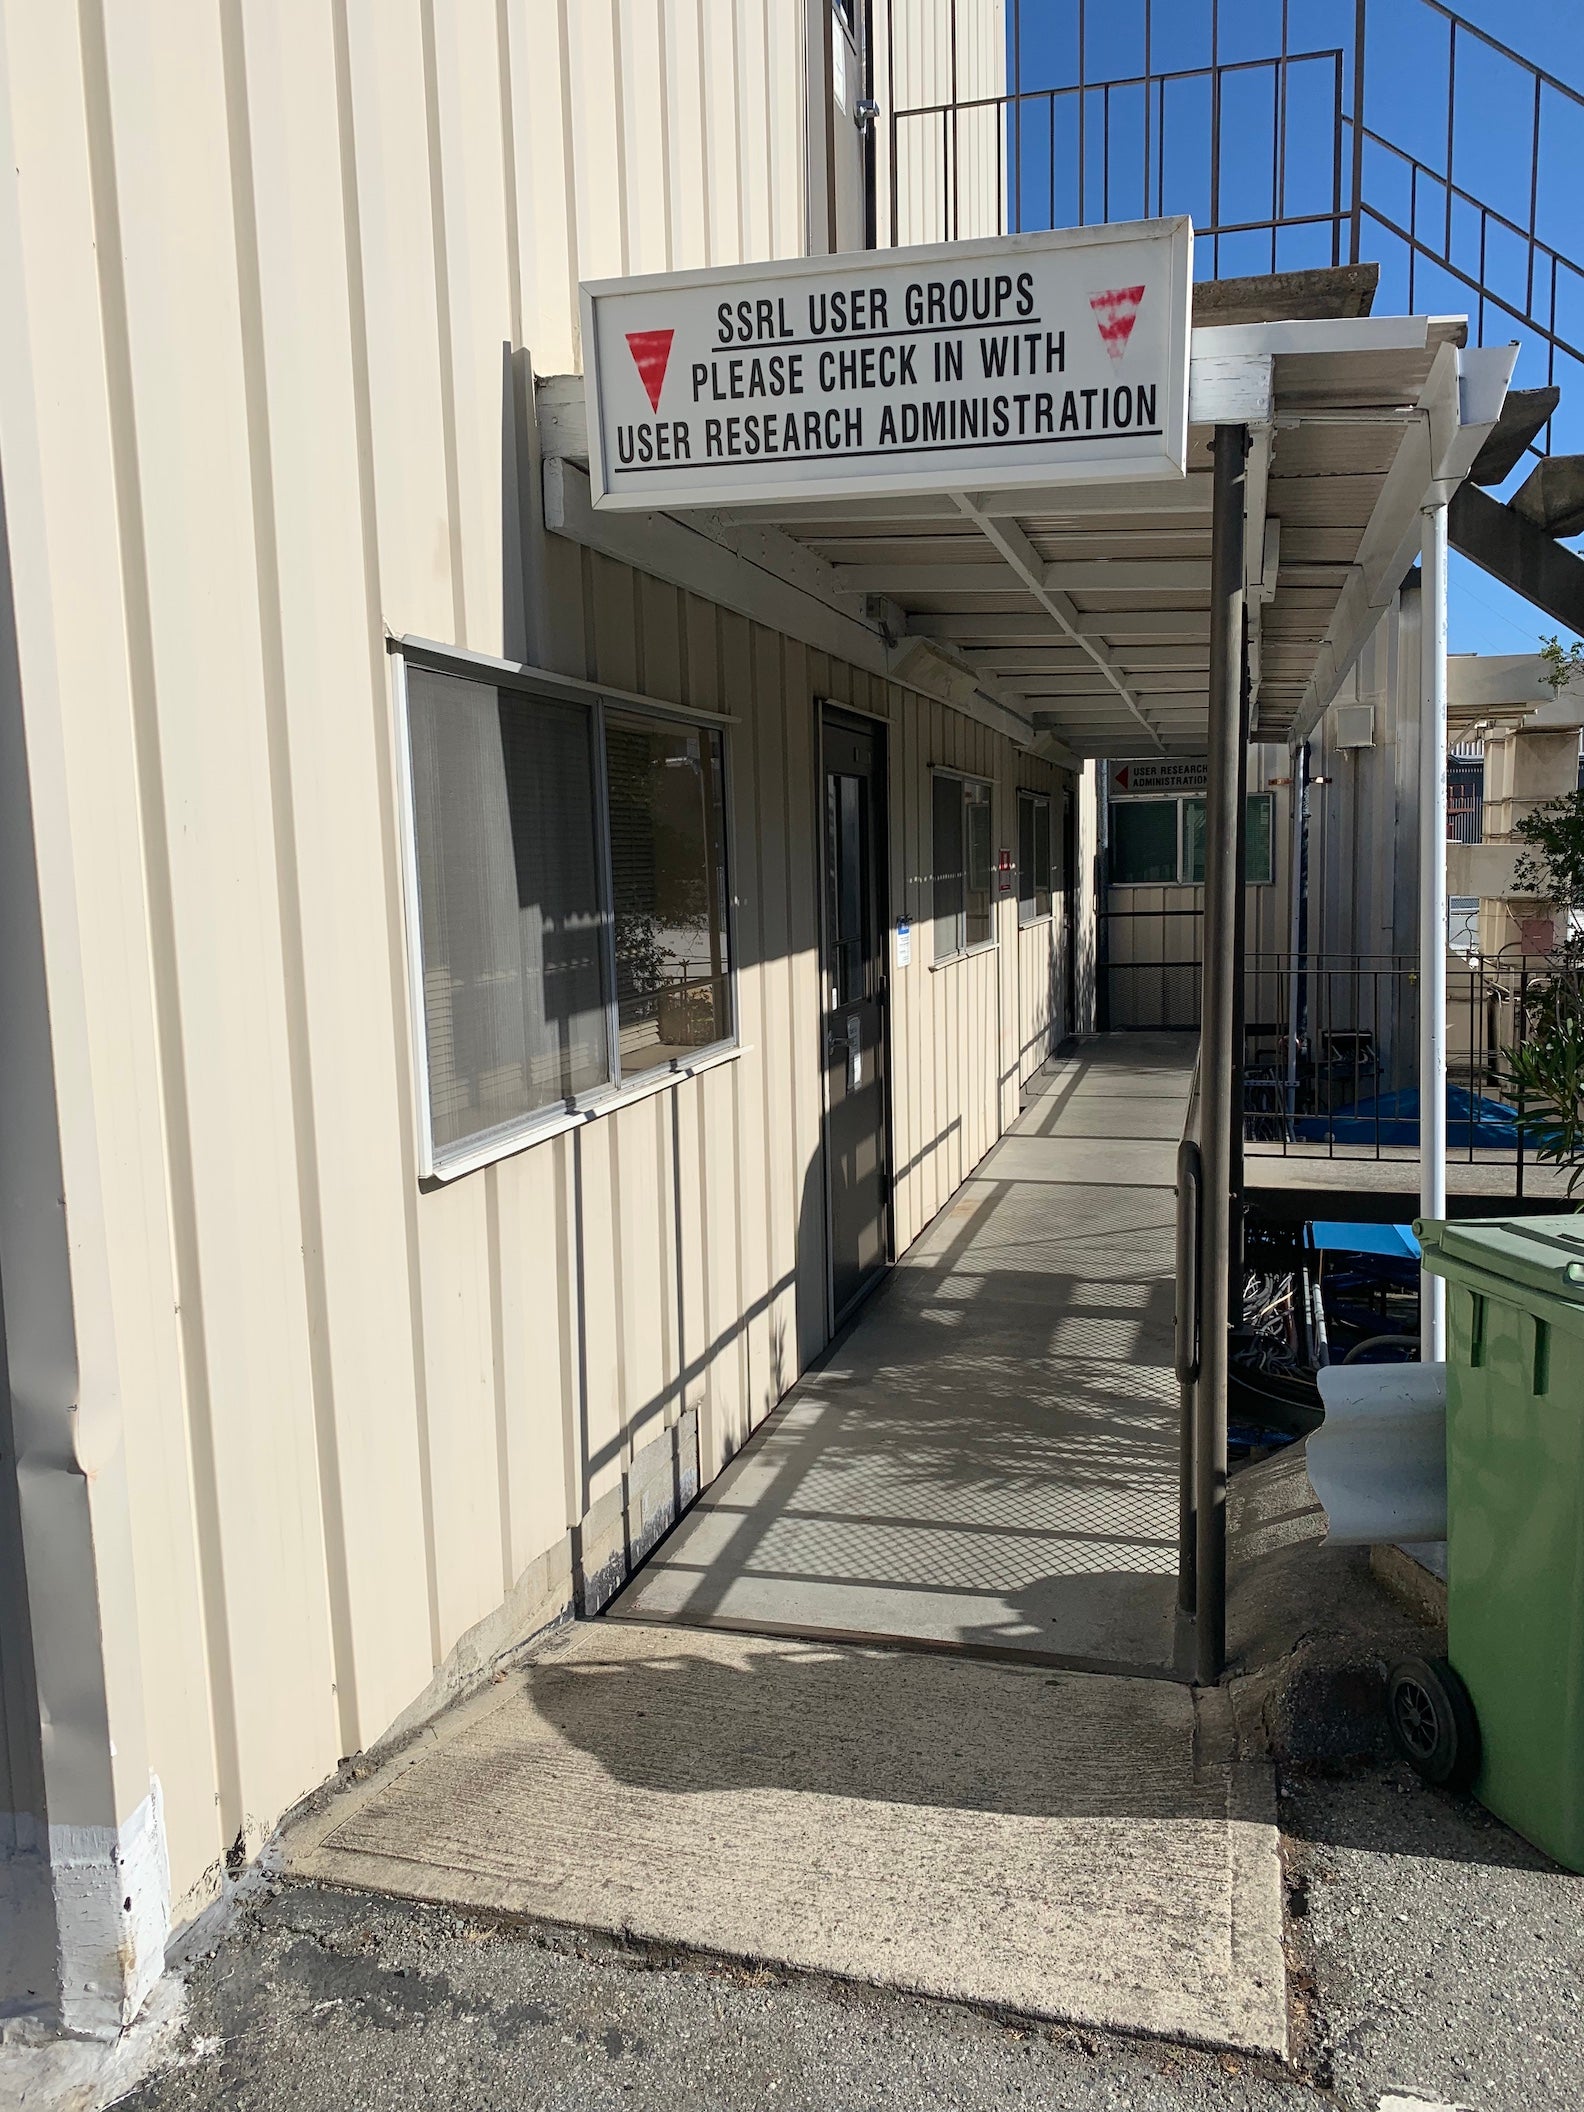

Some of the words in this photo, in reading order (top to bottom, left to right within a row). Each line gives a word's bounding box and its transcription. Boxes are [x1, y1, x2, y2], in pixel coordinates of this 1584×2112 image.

[717, 297, 794, 344] SSRL
[808, 288, 889, 336] USER
[905, 272, 1034, 327] GROUPS
[692, 354, 804, 403] PLEASE
[819, 344, 918, 393] CHECK
[934, 340, 963, 383] IN
[979, 330, 1065, 379] WITH
[617, 421, 691, 464] USER
[705, 407, 863, 458] RESEARCH
[878, 383, 1157, 446] ADMINISTRATION
[1133, 766, 1157, 776] USER
[1161, 763, 1208, 775] RESEARCH
